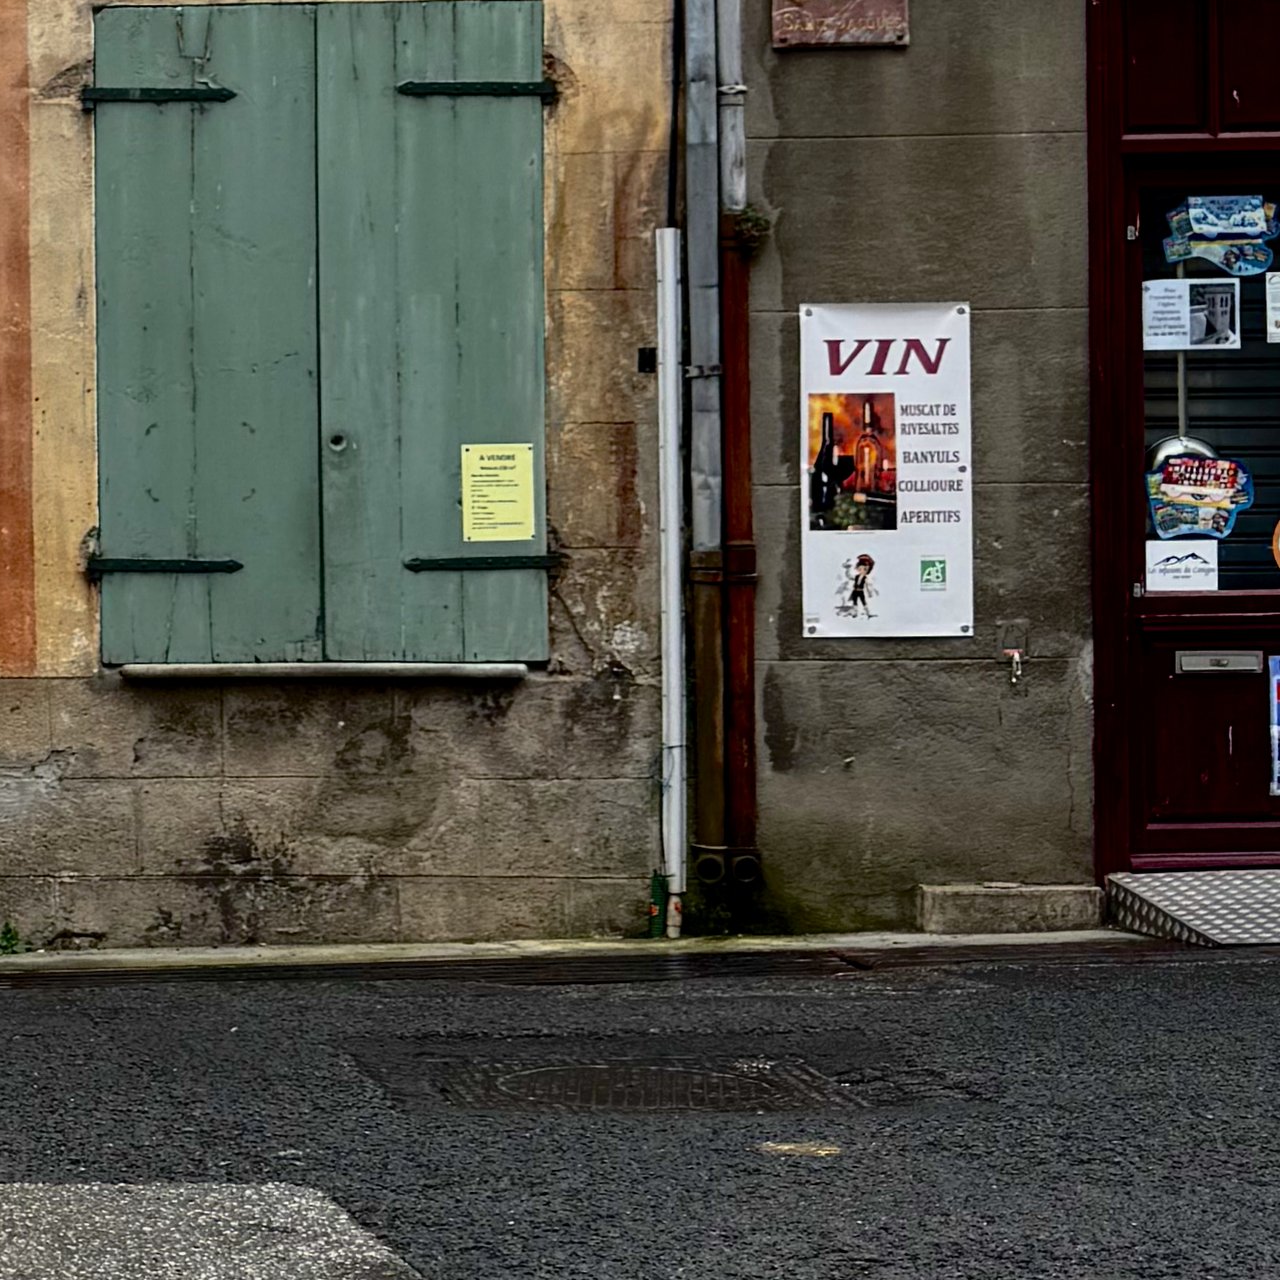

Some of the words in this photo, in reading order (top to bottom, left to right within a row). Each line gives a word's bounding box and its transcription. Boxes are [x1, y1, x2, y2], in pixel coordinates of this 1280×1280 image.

[823, 338, 952, 375] VIN
[900, 404, 941, 416] MUSCAT
[943, 404, 956, 416] DE
[900, 423, 959, 435] RIVESALTES
[902, 451, 960, 463] BANYULS
[898, 479, 964, 492] COLLIOURE
[900, 510, 961, 523] APERITIFS
